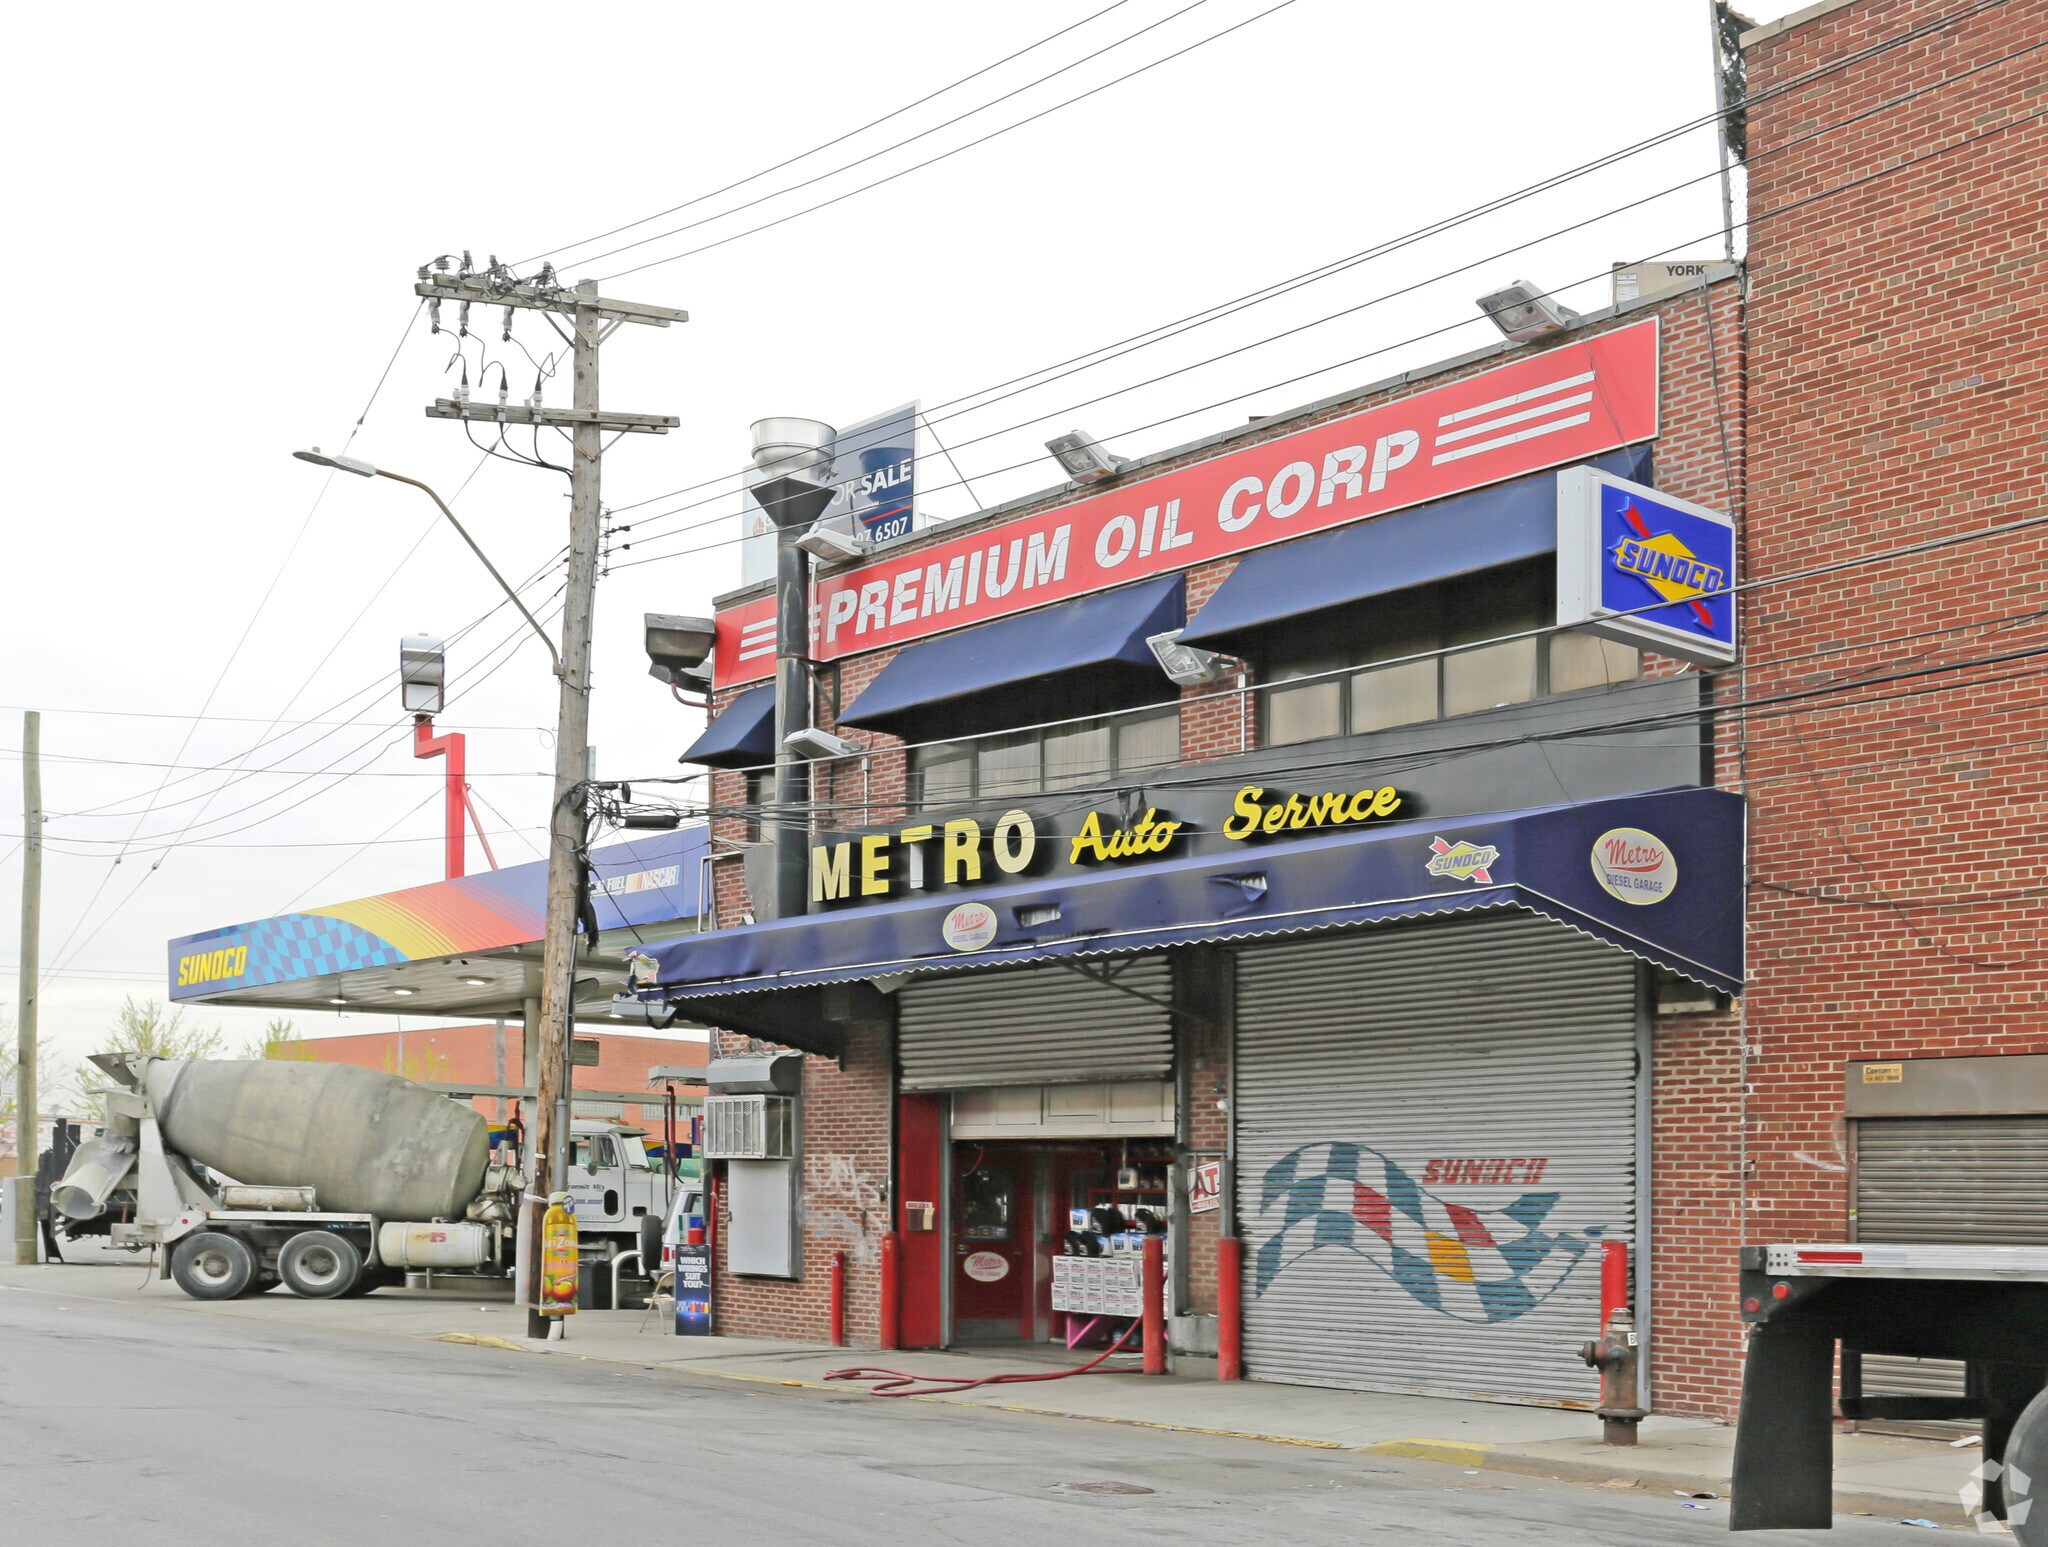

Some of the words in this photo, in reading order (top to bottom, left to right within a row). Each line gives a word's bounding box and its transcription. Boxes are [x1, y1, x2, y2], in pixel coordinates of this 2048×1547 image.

[1666, 265, 1706, 276] YORK
[830, 480, 857, 505] OR
[861, 458, 912, 496] SALE
[826, 523, 1072, 643] PREMIUM
[1094, 498, 1194, 569] OIL
[1217, 429, 1420, 533] CORP
[1620, 541, 1722, 593] SUNOCO
[812, 809, 1036, 902] METRO
[1070, 807, 1182, 864] Auto
[1222, 785, 1401, 841] Service
[1605, 839, 1664, 867] Metro
[1434, 850, 1492, 871] SUNOCO
[606, 876, 625, 891] FUEL
[642, 866, 679, 890] NASCAR
[1606, 874, 1632, 888] DIESEL
[1634, 878, 1663, 893] GARAGE
[952, 911, 989, 931] Metro
[952, 935, 969, 943] DIESEL
[969, 931, 989, 941] GARAGE
[178, 945, 247, 986] SUNOCO
[1422, 1158, 1548, 1185] SUNOCO
[680, 1257, 706, 1265] WHICH
[682, 1280, 704, 1289] YOU?
[685, 1272, 701, 1280] SUIT
